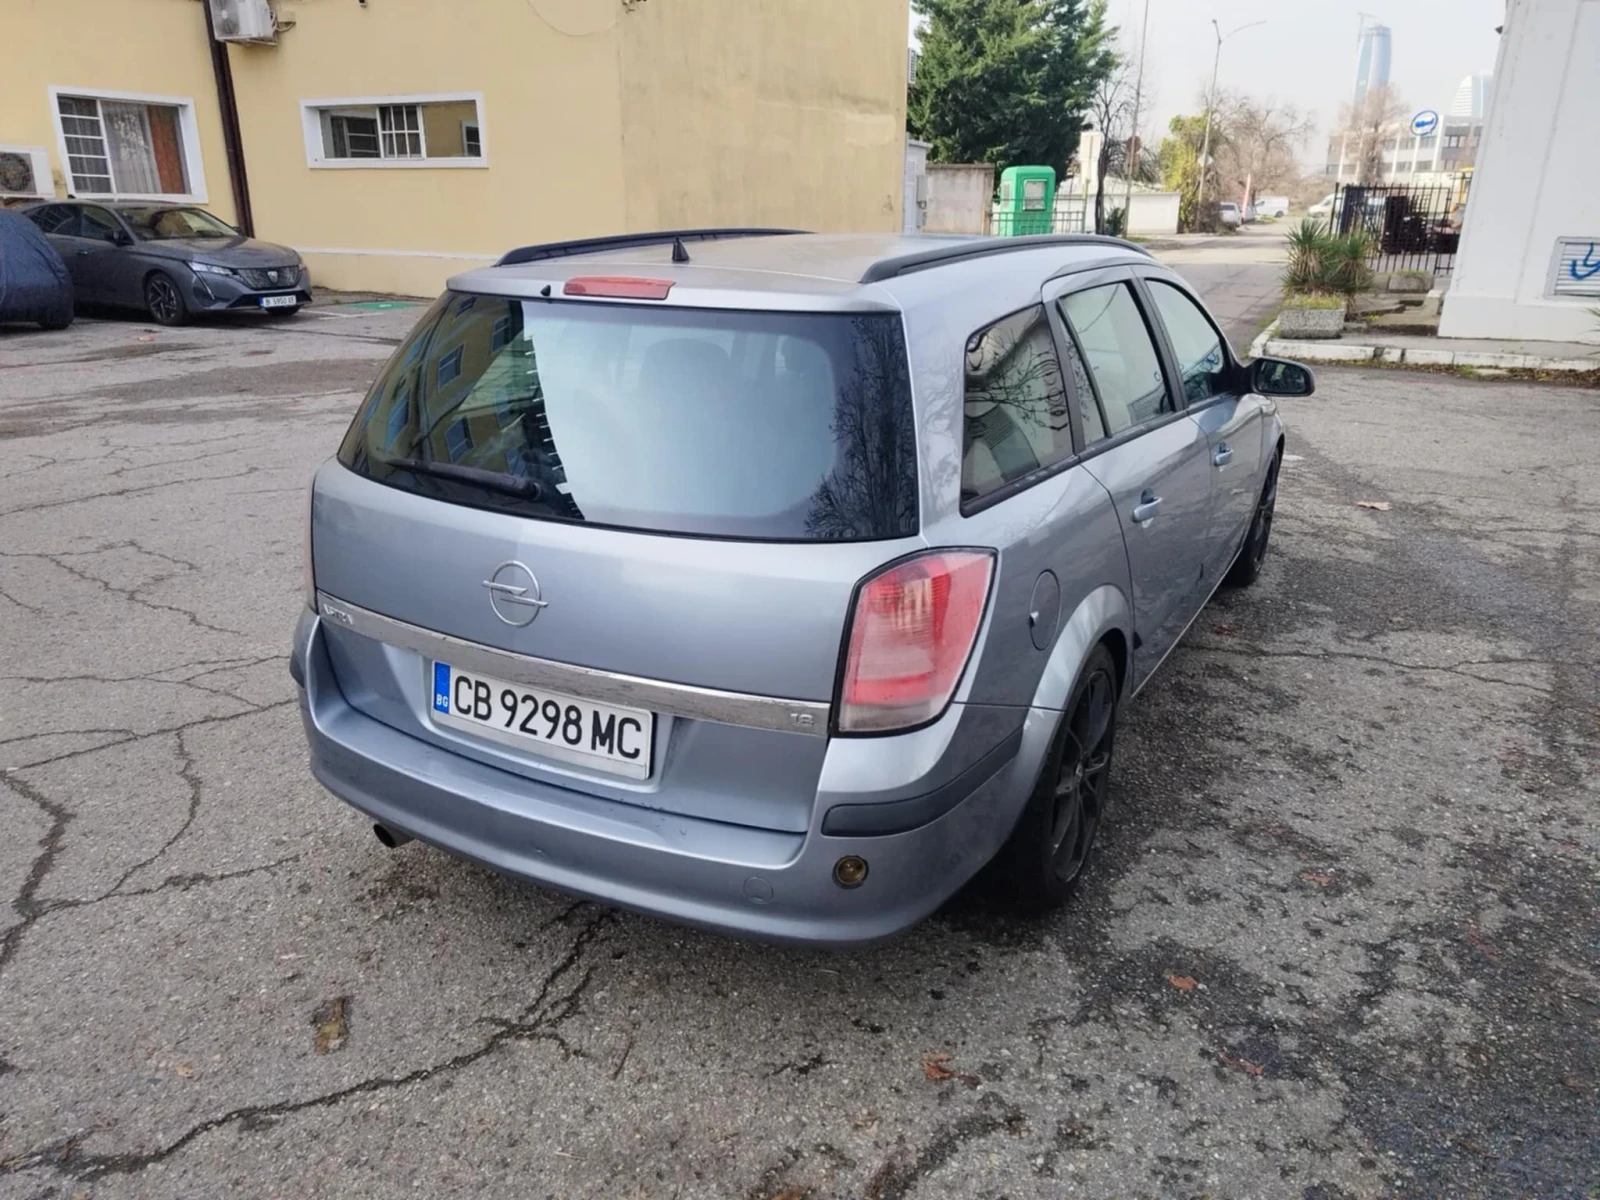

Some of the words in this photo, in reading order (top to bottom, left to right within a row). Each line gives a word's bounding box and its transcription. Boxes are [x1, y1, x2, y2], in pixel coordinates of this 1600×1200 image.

[435, 693, 449, 708] BG
[454, 675, 492, 721] CB
[500, 689, 582, 745] 9298
[591, 710, 642, 760] MC
